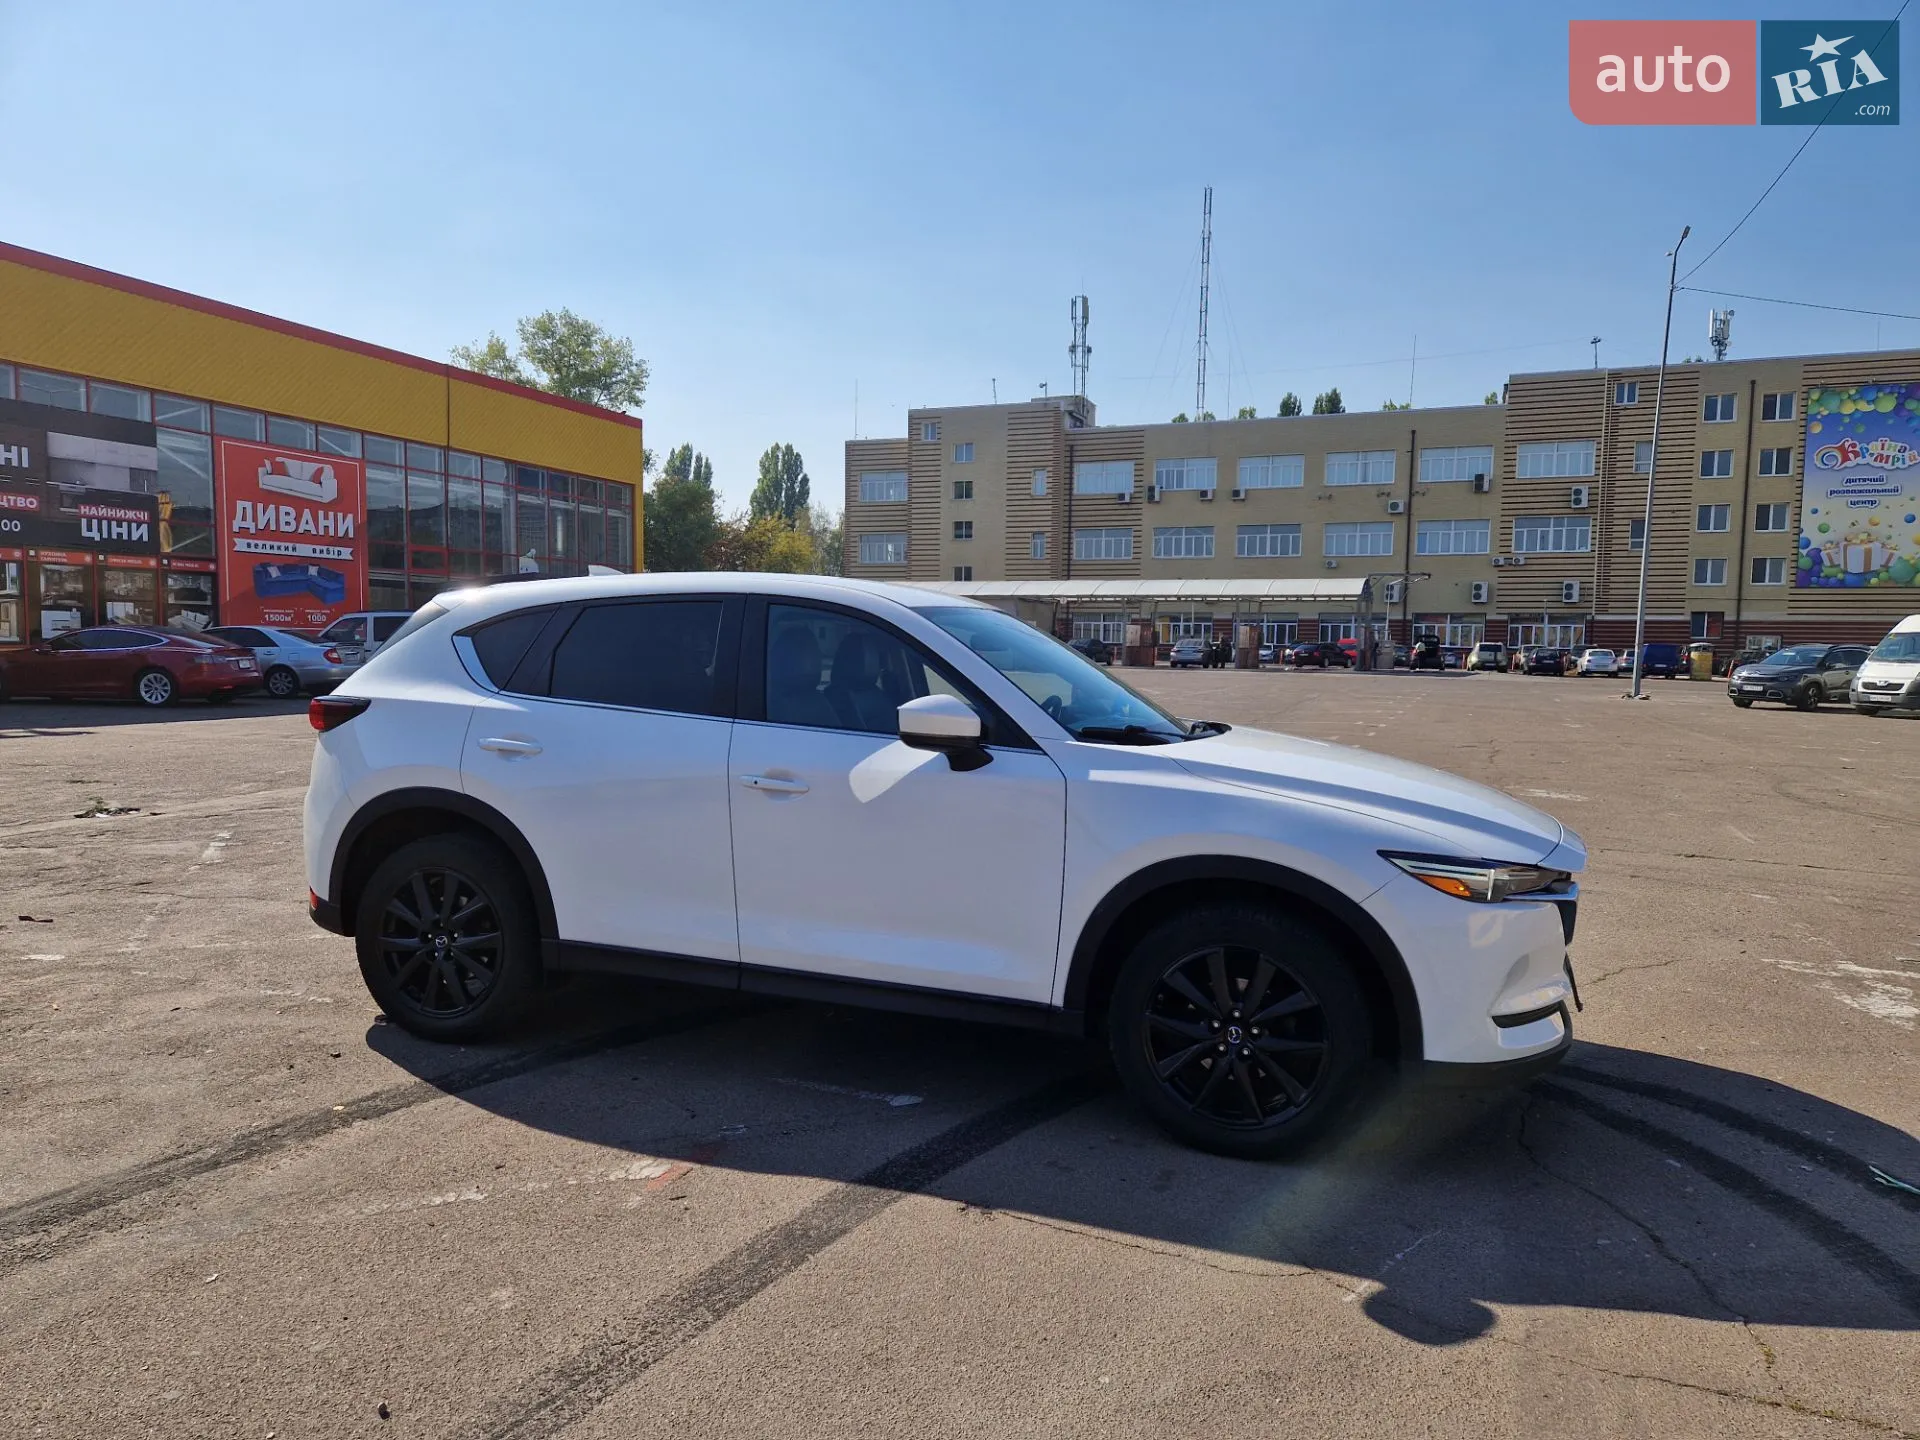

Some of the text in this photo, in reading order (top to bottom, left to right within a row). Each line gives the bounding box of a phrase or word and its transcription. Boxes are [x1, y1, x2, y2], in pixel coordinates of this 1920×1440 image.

[1844, 475, 1884, 485] дитячий
[1829, 486, 1899, 496] розважальний
[80, 504, 148, 520] НАЙНИЖЧІ
[232, 500, 354, 538] ДИВАНИ
[81, 518, 149, 542] ЦІНИ
[246, 541, 342, 558] великий вибір
